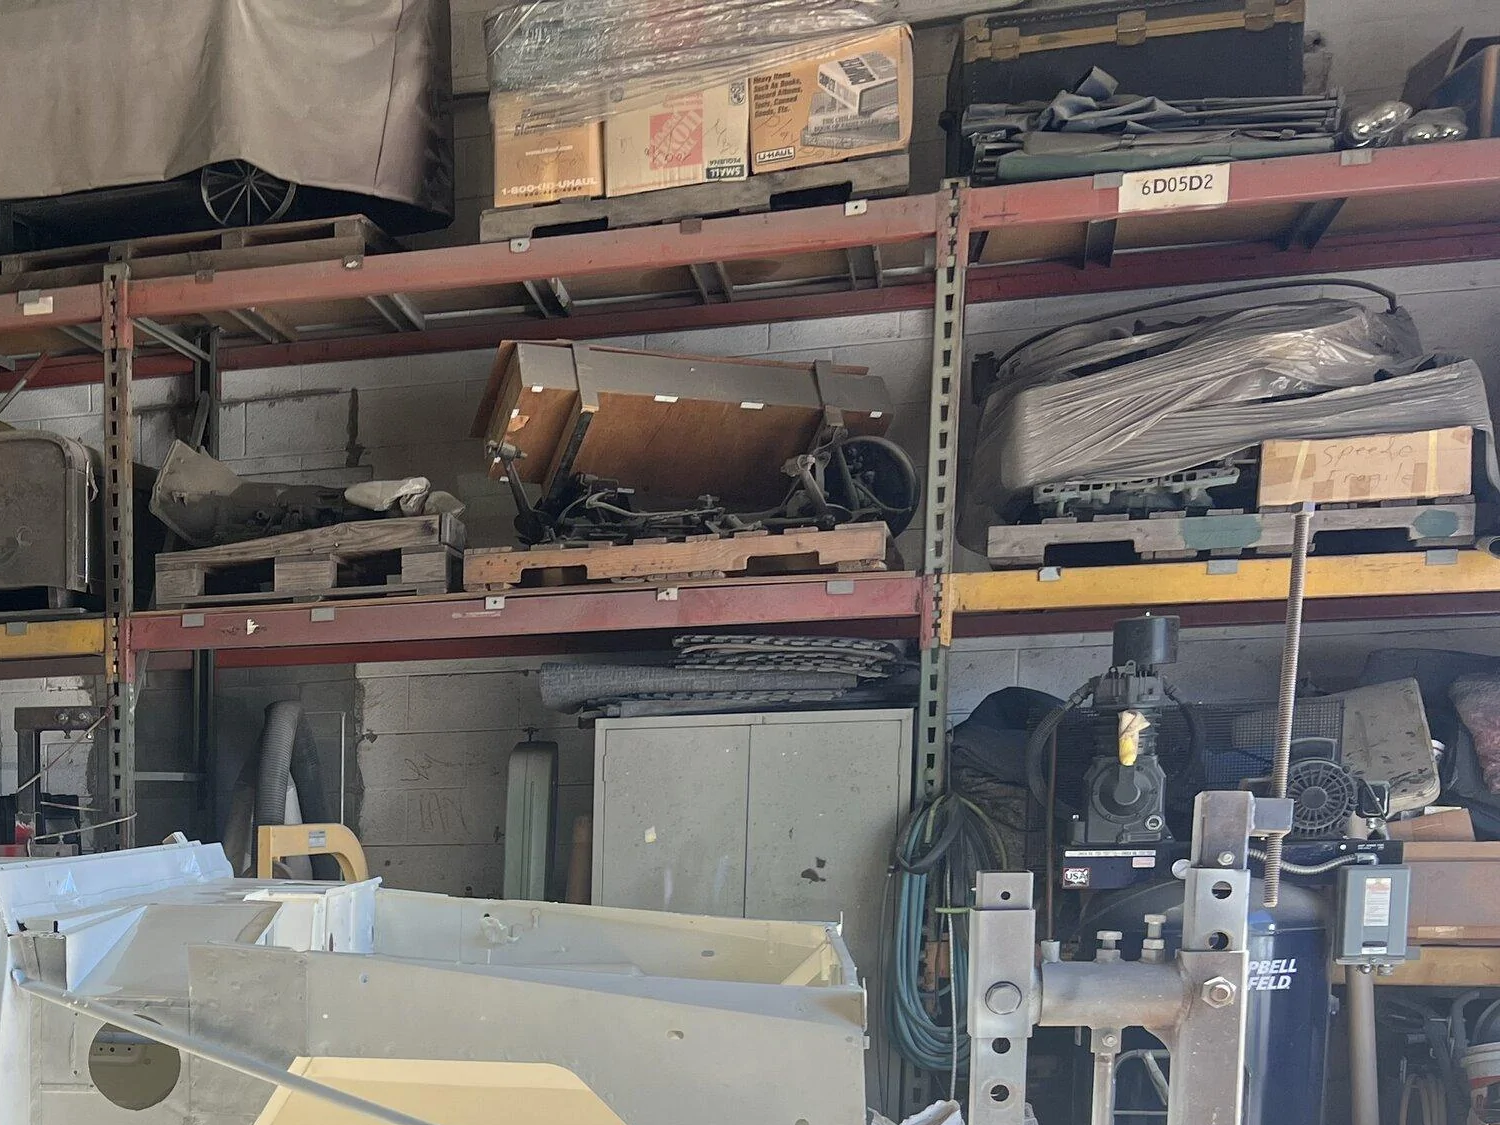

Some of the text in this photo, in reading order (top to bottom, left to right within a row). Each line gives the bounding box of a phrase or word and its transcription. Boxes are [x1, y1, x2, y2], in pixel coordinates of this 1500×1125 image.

[753, 84, 769, 92] Such
[758, 149, 793, 160] U-HAUL
[710, 166, 741, 177] SMALL
[1141, 174, 1214, 196] 6D05D2
[1066, 872, 1089, 881] USA
